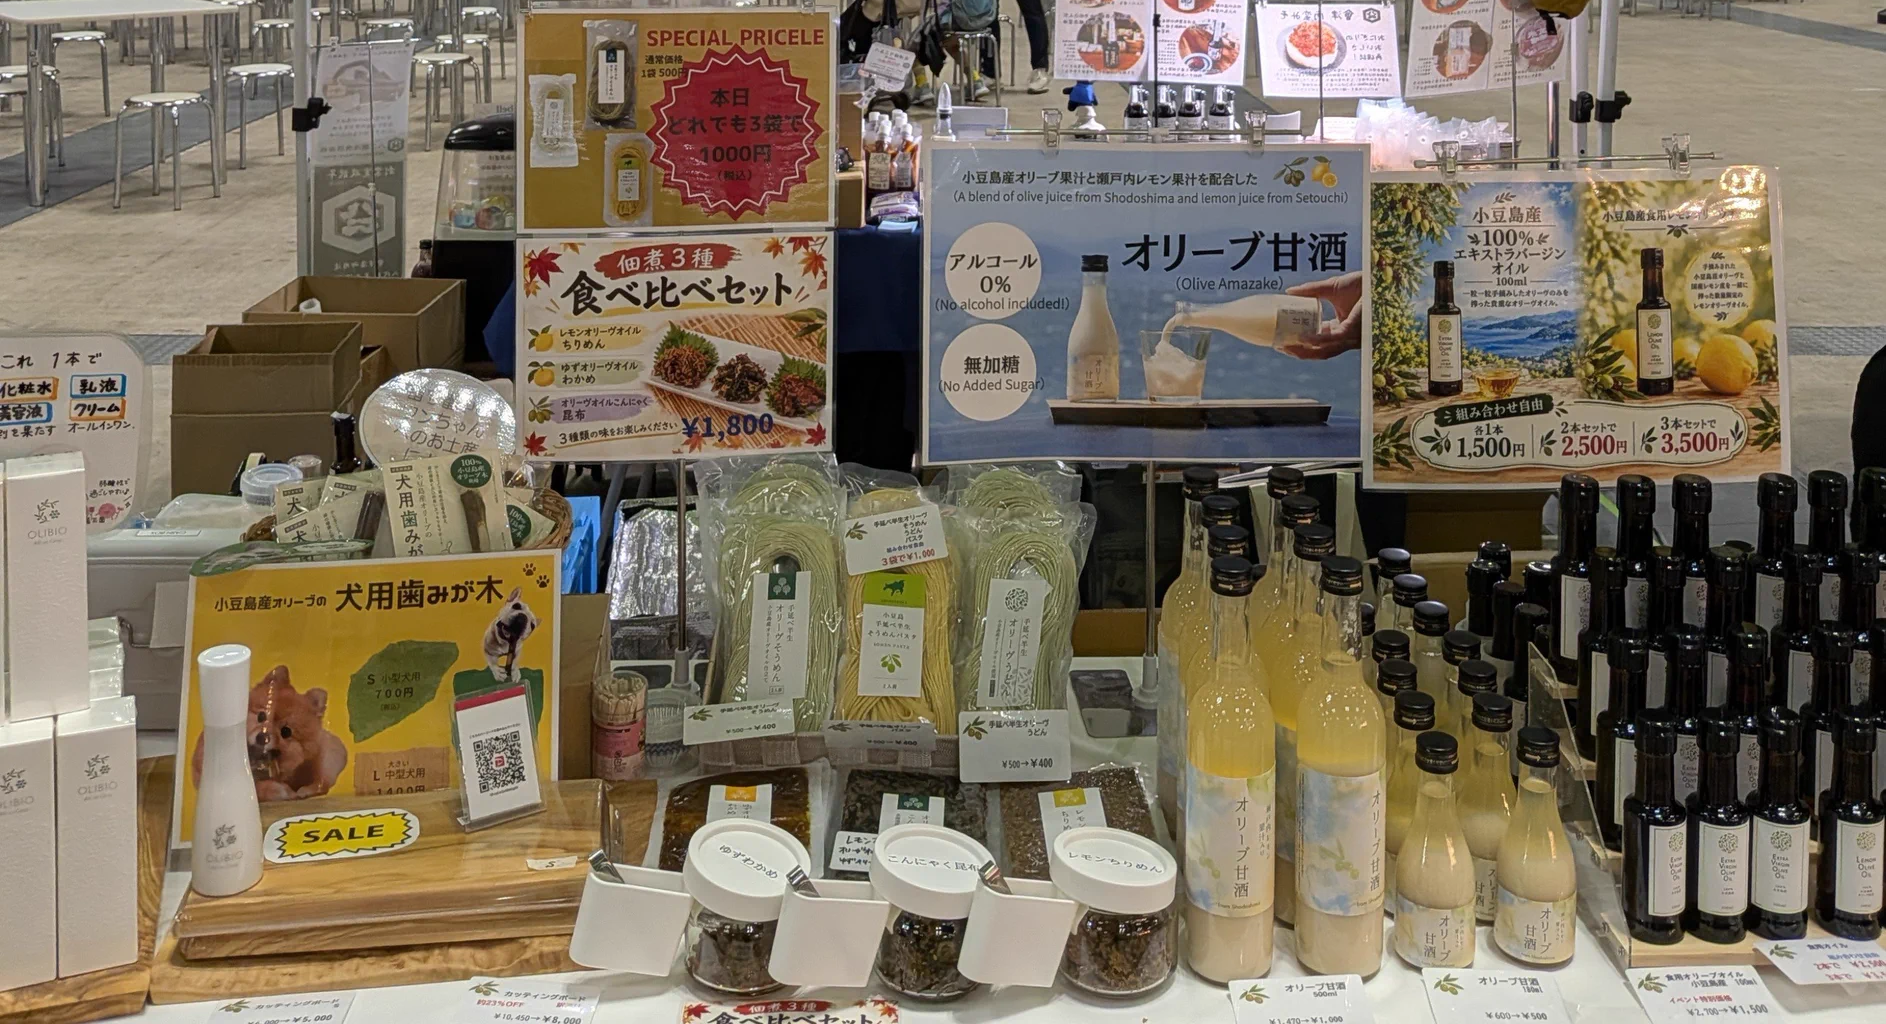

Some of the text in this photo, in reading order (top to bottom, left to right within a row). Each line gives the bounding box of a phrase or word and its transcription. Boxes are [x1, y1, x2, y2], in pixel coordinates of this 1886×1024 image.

[647, 29, 824, 46] SPECIAL PRICELE
[645, 55, 683, 64] 通常価格
[642, 69, 656, 78] 1袋
[710, 88, 748, 107] 本日
[668, 114, 804, 134] どれでも3袋で
[700, 144, 771, 163] 1000円
[961, 171, 1257, 187] 小豆島産オリーブ果汁と瀬戸内レモン果汁を配合した
[953, 191, 1349, 204] (A blend of olive juice from Shodoshima and lemon juice from Setouchi)
[1473, 206, 1541, 224] 小豆島産
[1483, 229, 1534, 246] 100%
[1122, 230, 1348, 273] オリーブ甘酒
[1454, 247, 1566, 261] エキストラバージン
[617, 248, 714, 273] 佃煮3種
[949, 253, 1038, 270] アルコール
[1492, 262, 1529, 275] オイル
[979, 276, 1011, 294] 0%
[1174, 276, 1284, 292] (Olive Amazake)
[1496, 277, 1527, 286] 100ml
[561, 271, 792, 316] 食べ比べセット
[935, 297, 1070, 312] (No alcohol included!)
[559, 326, 642, 336] レモンオリーヴオイル
[562, 339, 606, 349] ちりめん
[1, 352, 102, 369] これ 1本で
[561, 361, 638, 373] ゆずオリーヴオイル
[964, 355, 1020, 375] 無加糖
[79, 379, 118, 394] 乳液
[562, 374, 596, 385] わかめ
[938, 378, 1046, 393] (No Added Sugar)
[0, 382, 52, 399] 化粧水
[74, 403, 120, 417] クリーム
[561, 396, 648, 408] オリーヴオイルこんにゃく
[1456, 399, 1544, 421] 組み合わせ自由
[0, 405, 43, 420] 美容液
[562, 409, 586, 421] 昆布
[682, 413, 774, 441] ¥1,800
[1474, 425, 1504, 436] 各1本
[1561, 421, 1616, 434] 2本セットで
[1661, 416, 1716, 430] 3本セットで
[559, 421, 678, 445] 3種類の味をお楽しみください
[1457, 436, 1525, 458] 1,500円
[1561, 434, 1627, 457] 2,500円
[1661, 431, 1729, 454] 3,500円
[287, 497, 301, 515] 犬
[395, 473, 424, 556] 犬用歯みが
[874, 512, 928, 528] 手延べ半生オリーヴ
[903, 520, 927, 529] そうめん
[904, 527, 923, 536] うどん
[27, 527, 68, 539] OLIBIO
[905, 535, 924, 543] パスタ
[215, 575, 503, 613] 小豆島産オリーブの 犬用歯みが木
[772, 604, 784, 682] オリーヴそうめん
[868, 630, 917, 640] そうめんパスタ
[367, 672, 421, 685] S 小型犬用
[376, 687, 414, 699] 700円
[989, 719, 1049, 728] 手延べ半生オリーヴ
[1002, 758, 1053, 768] ¥500 ¥400
[373, 767, 425, 781] L 中型犬用
[77, 781, 118, 795] OLIBIO
[302, 823, 384, 844] SALE
[1370, 790, 1381, 892] オリーブ甘酒
[1234, 797, 1250, 898] オリーブ甘酒
[720, 845, 777, 878] ゆずわかめ
[888, 854, 979, 872] こんにゃく昆布
[1069, 852, 1162, 874] レモンちりめん
[1439, 915, 1451, 962] オリーブ
[1524, 924, 1537, 950] 甘酒
[1540, 908, 1552, 954] オリーブ
[1424, 932, 1436, 958] 甘酒
[1284, 981, 1346, 992] オリーブ甘酒
[1478, 976, 1539, 987] オリーブ甘酒
[504, 991, 586, 1002] カッティングボード
